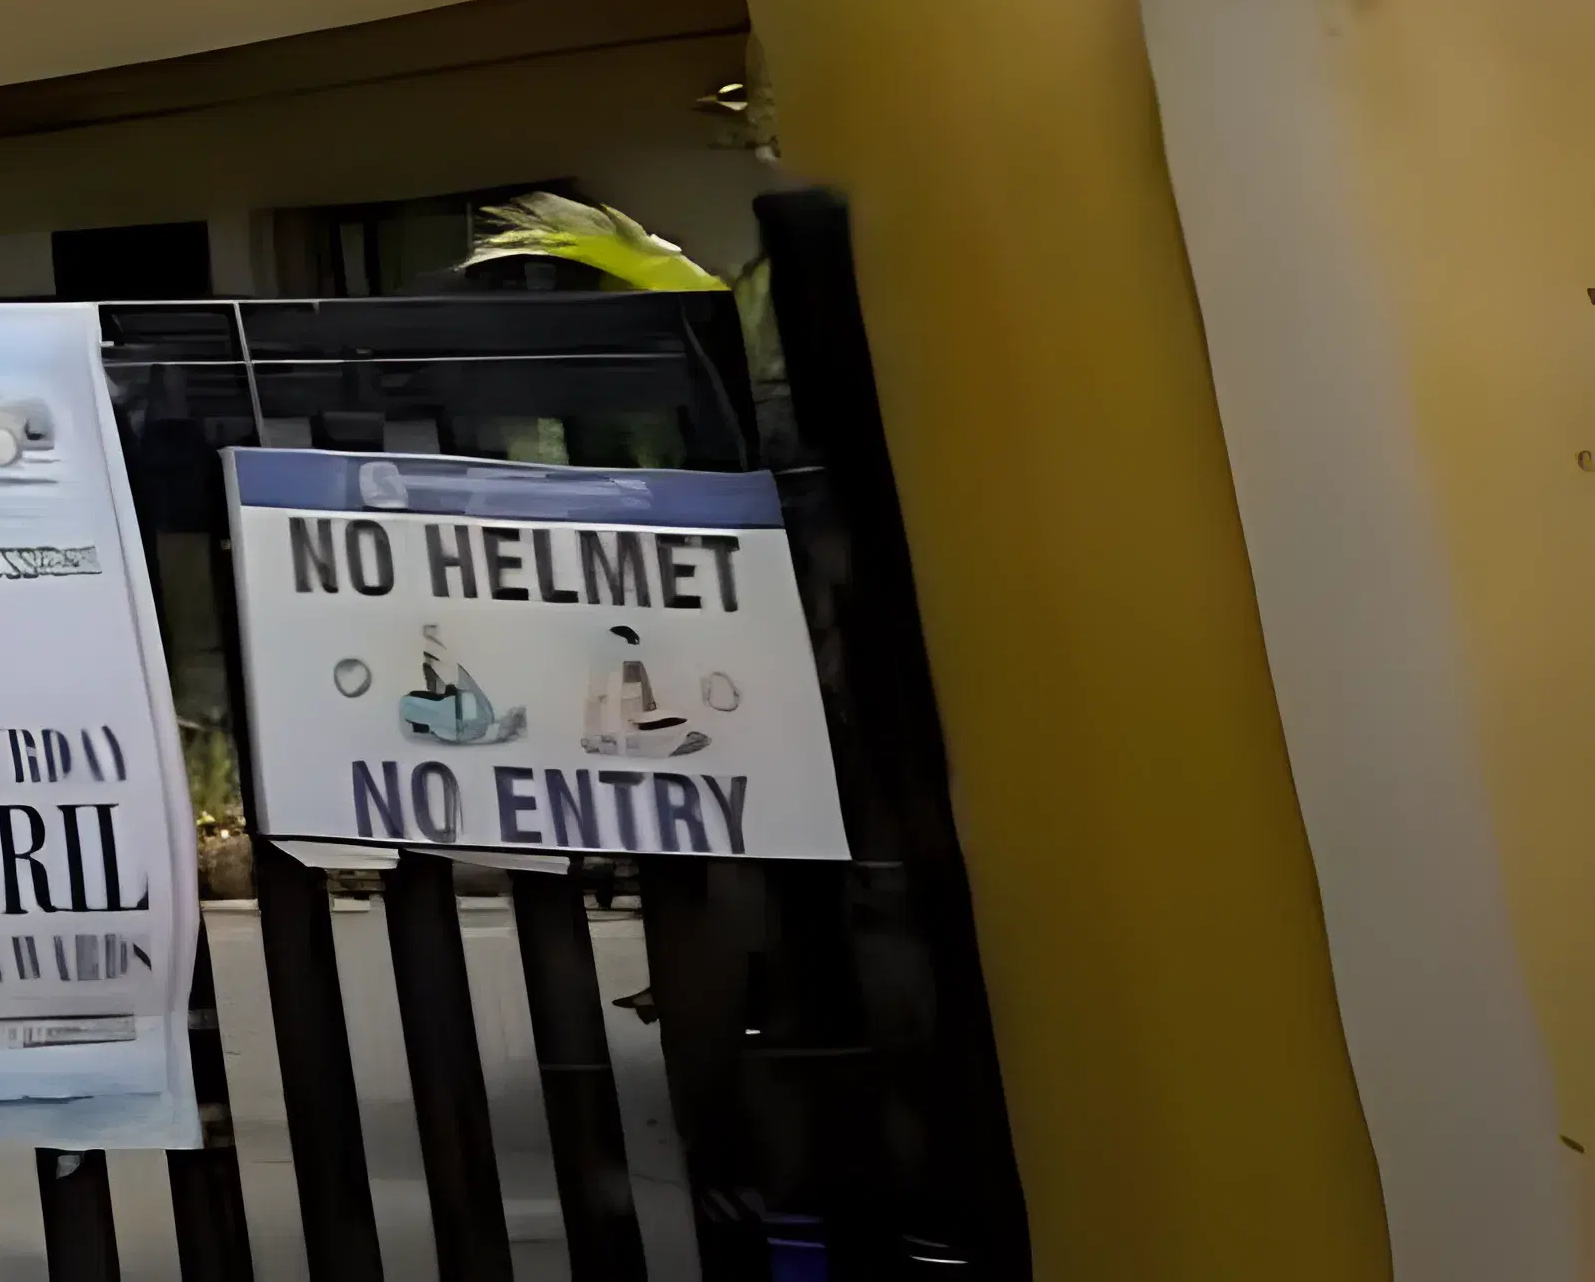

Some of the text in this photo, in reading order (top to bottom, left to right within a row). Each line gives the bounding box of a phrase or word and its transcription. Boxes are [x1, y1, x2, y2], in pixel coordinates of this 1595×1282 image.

[288, 516, 741, 613] NO HELMET
[351, 759, 748, 855] NO ENTRY
